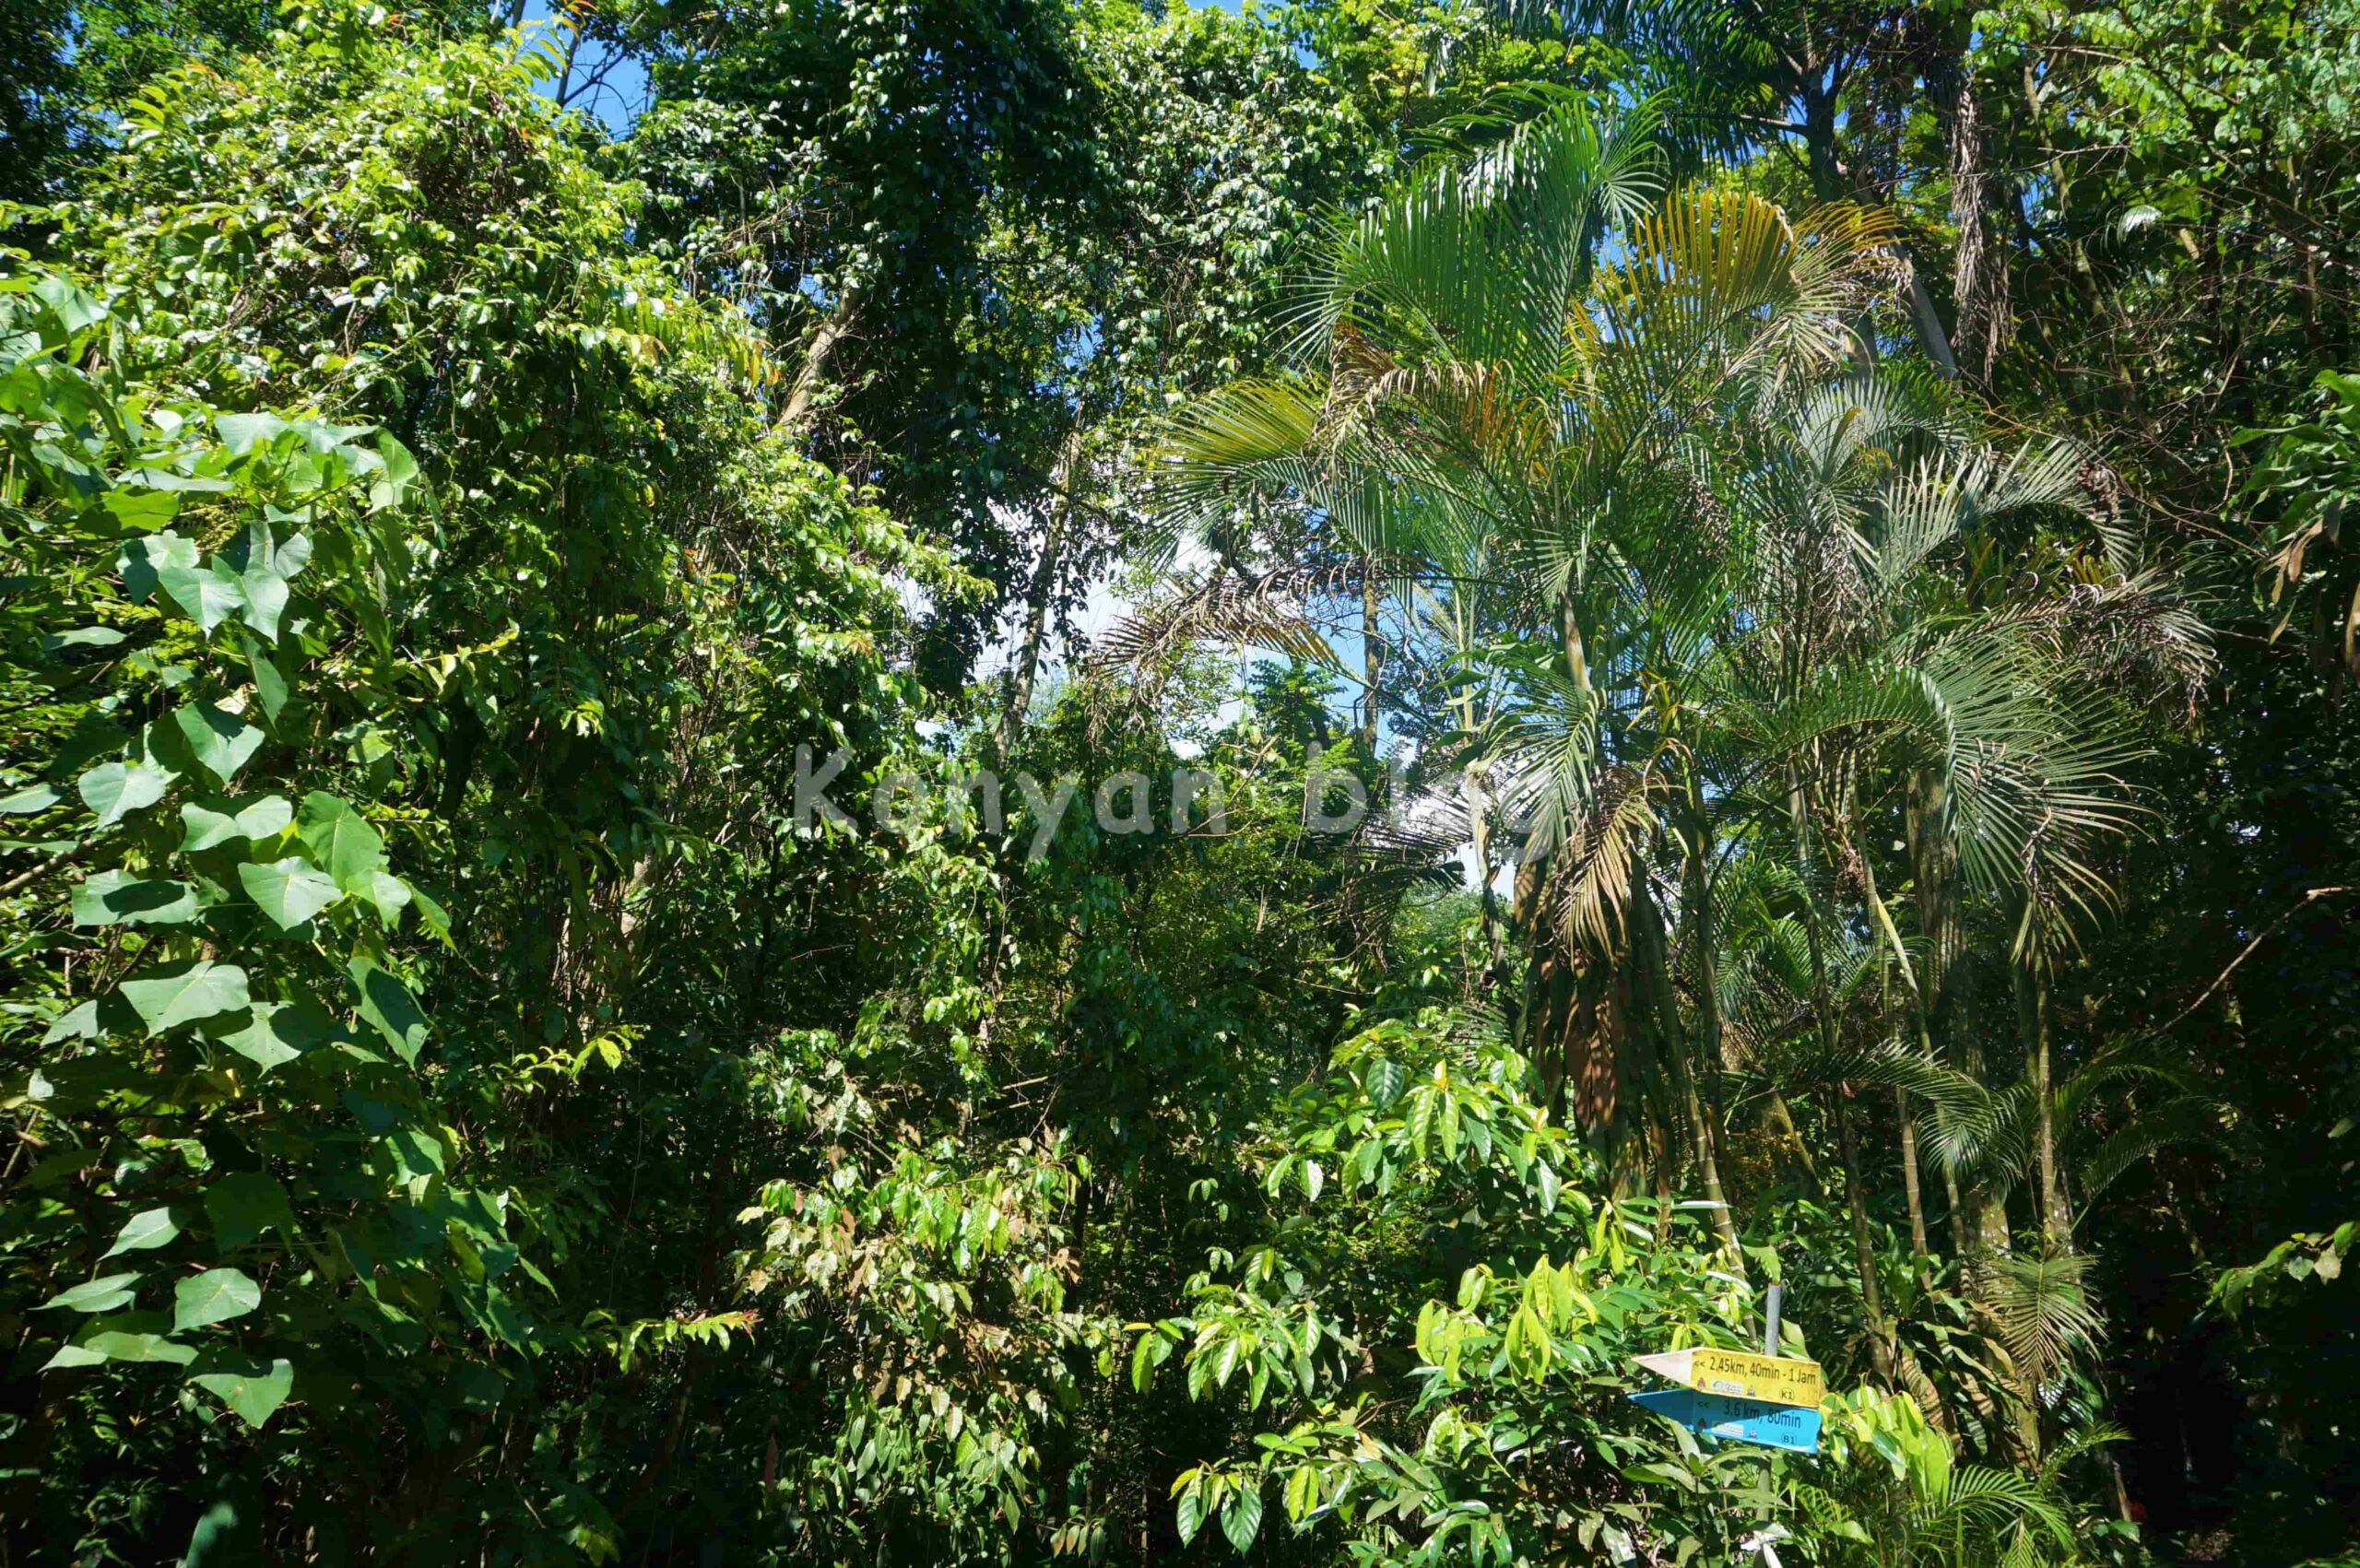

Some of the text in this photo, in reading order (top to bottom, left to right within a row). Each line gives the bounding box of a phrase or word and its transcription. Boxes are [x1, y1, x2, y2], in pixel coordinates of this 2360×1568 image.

[1750, 1362, 1780, 1380] 40min
[1797, 1369, 1816, 1385] Jam
[1781, 1390, 1792, 1400] K1
[1724, 1400, 1801, 1429] 3.6 km, 80min
